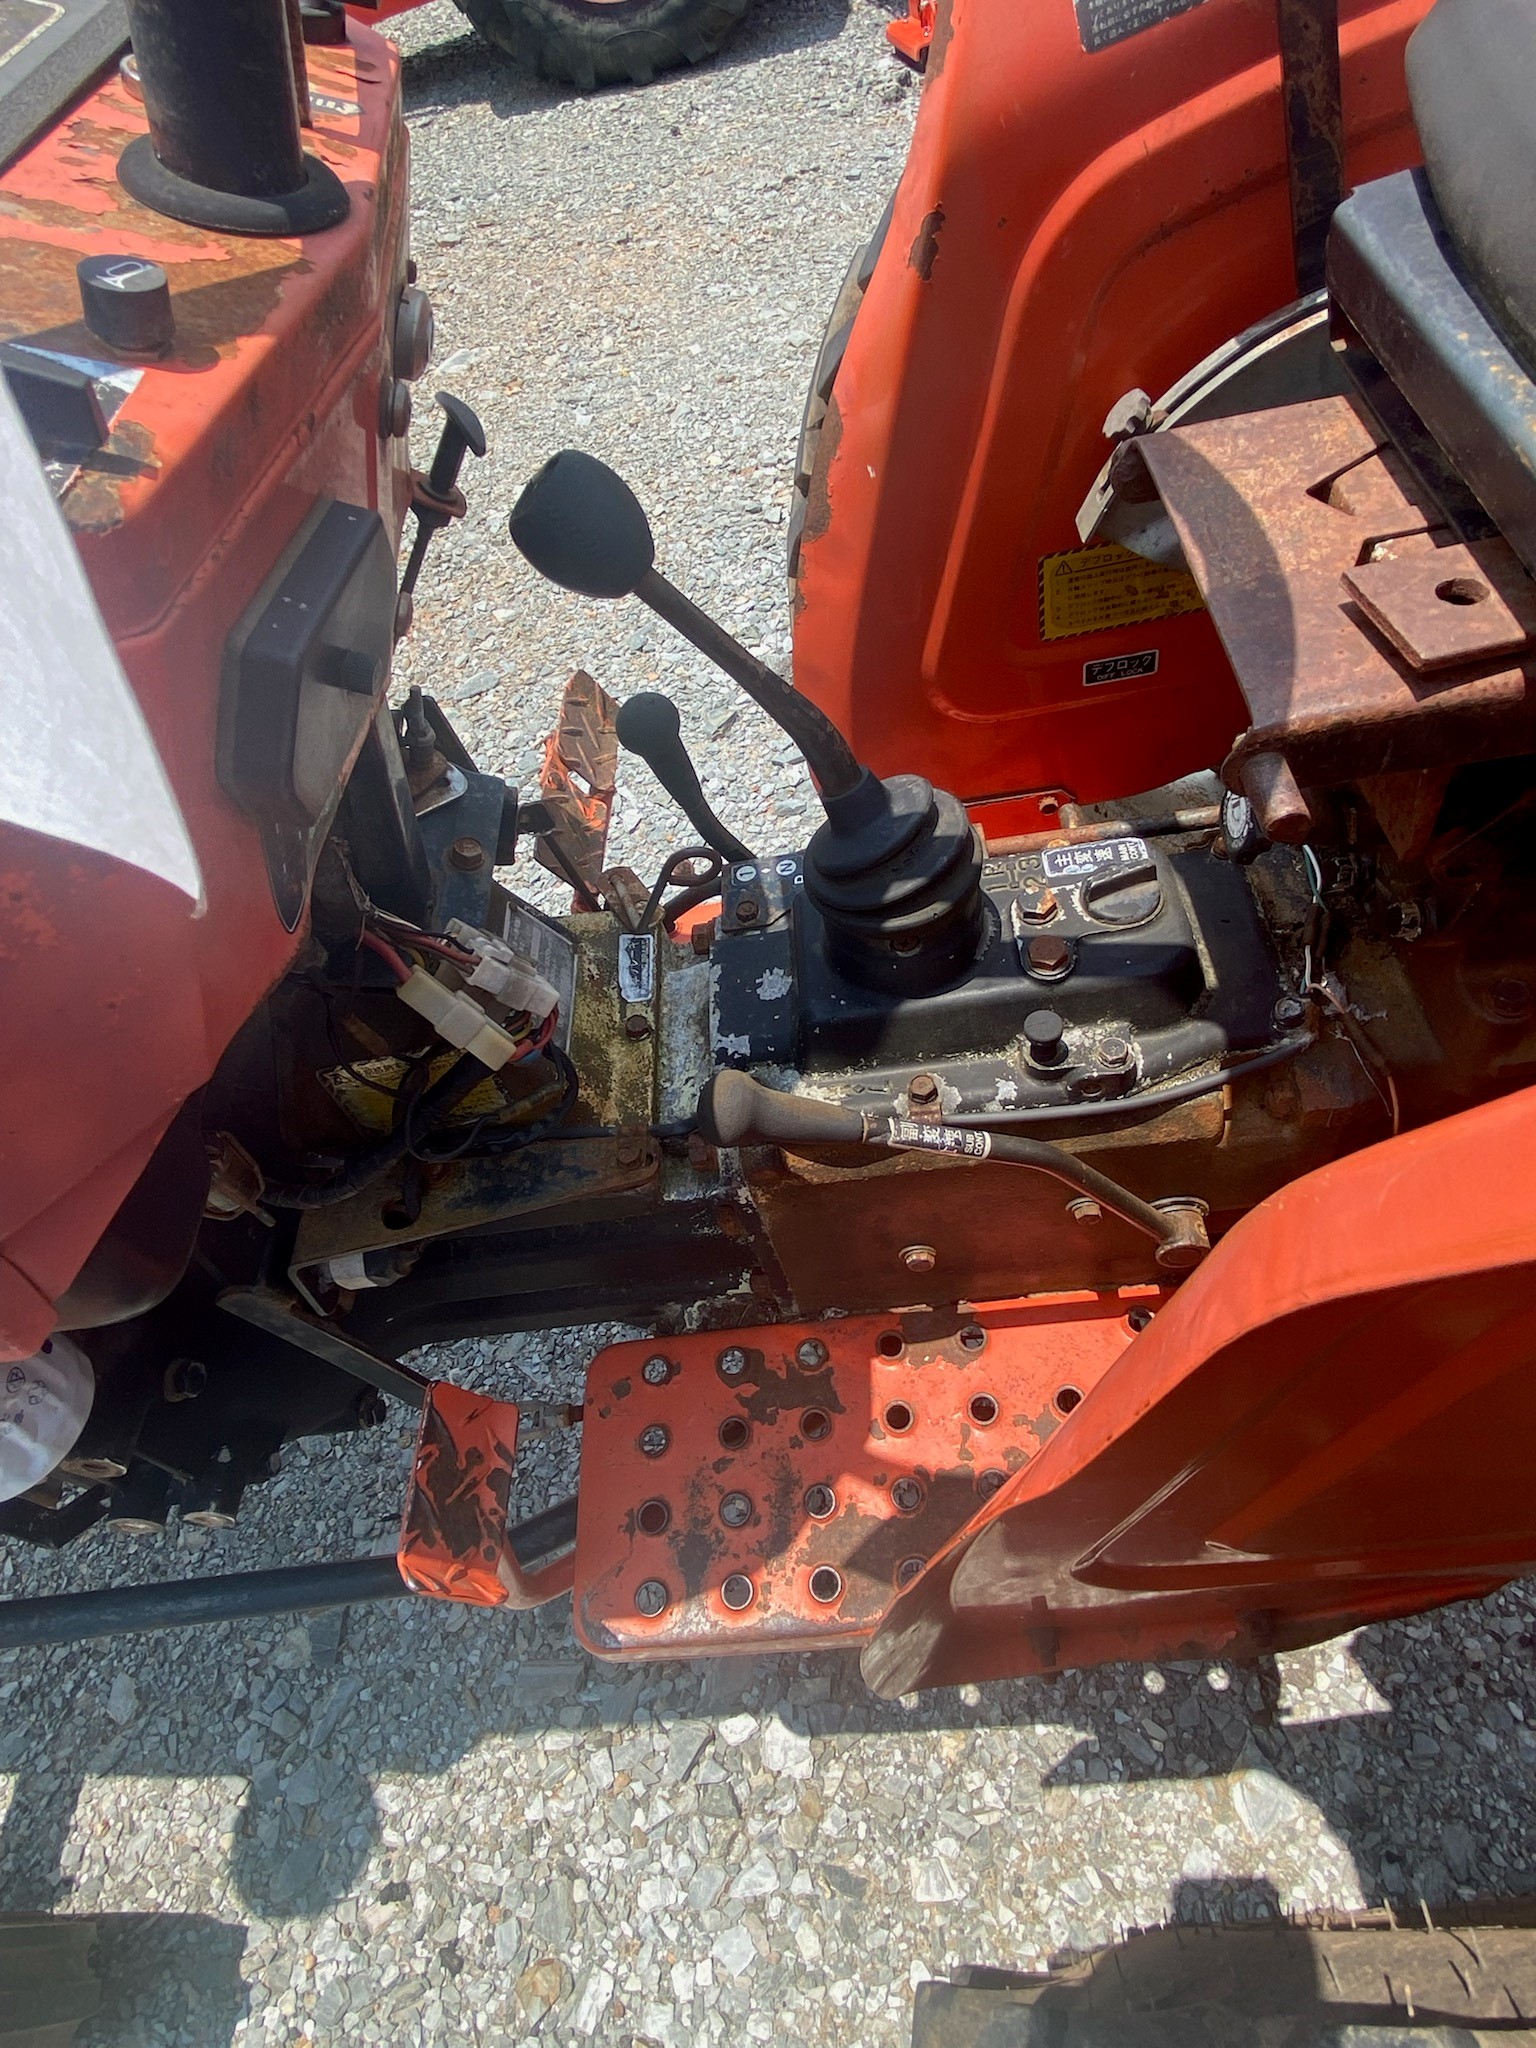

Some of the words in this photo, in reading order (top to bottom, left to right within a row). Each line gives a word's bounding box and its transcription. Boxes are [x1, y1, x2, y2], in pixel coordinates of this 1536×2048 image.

[1091, 655, 1152, 676] デフロック
[1120, 667, 1144, 677] LOCK
[1054, 846, 1114, 868] 主変速
[1117, 843, 1131, 862] MAIN
[1127, 841, 1139, 860] CONT
[780, 862, 793, 873] N
[964, 1133, 975, 1154] SUB
[973, 1130, 985, 1156] CONT
